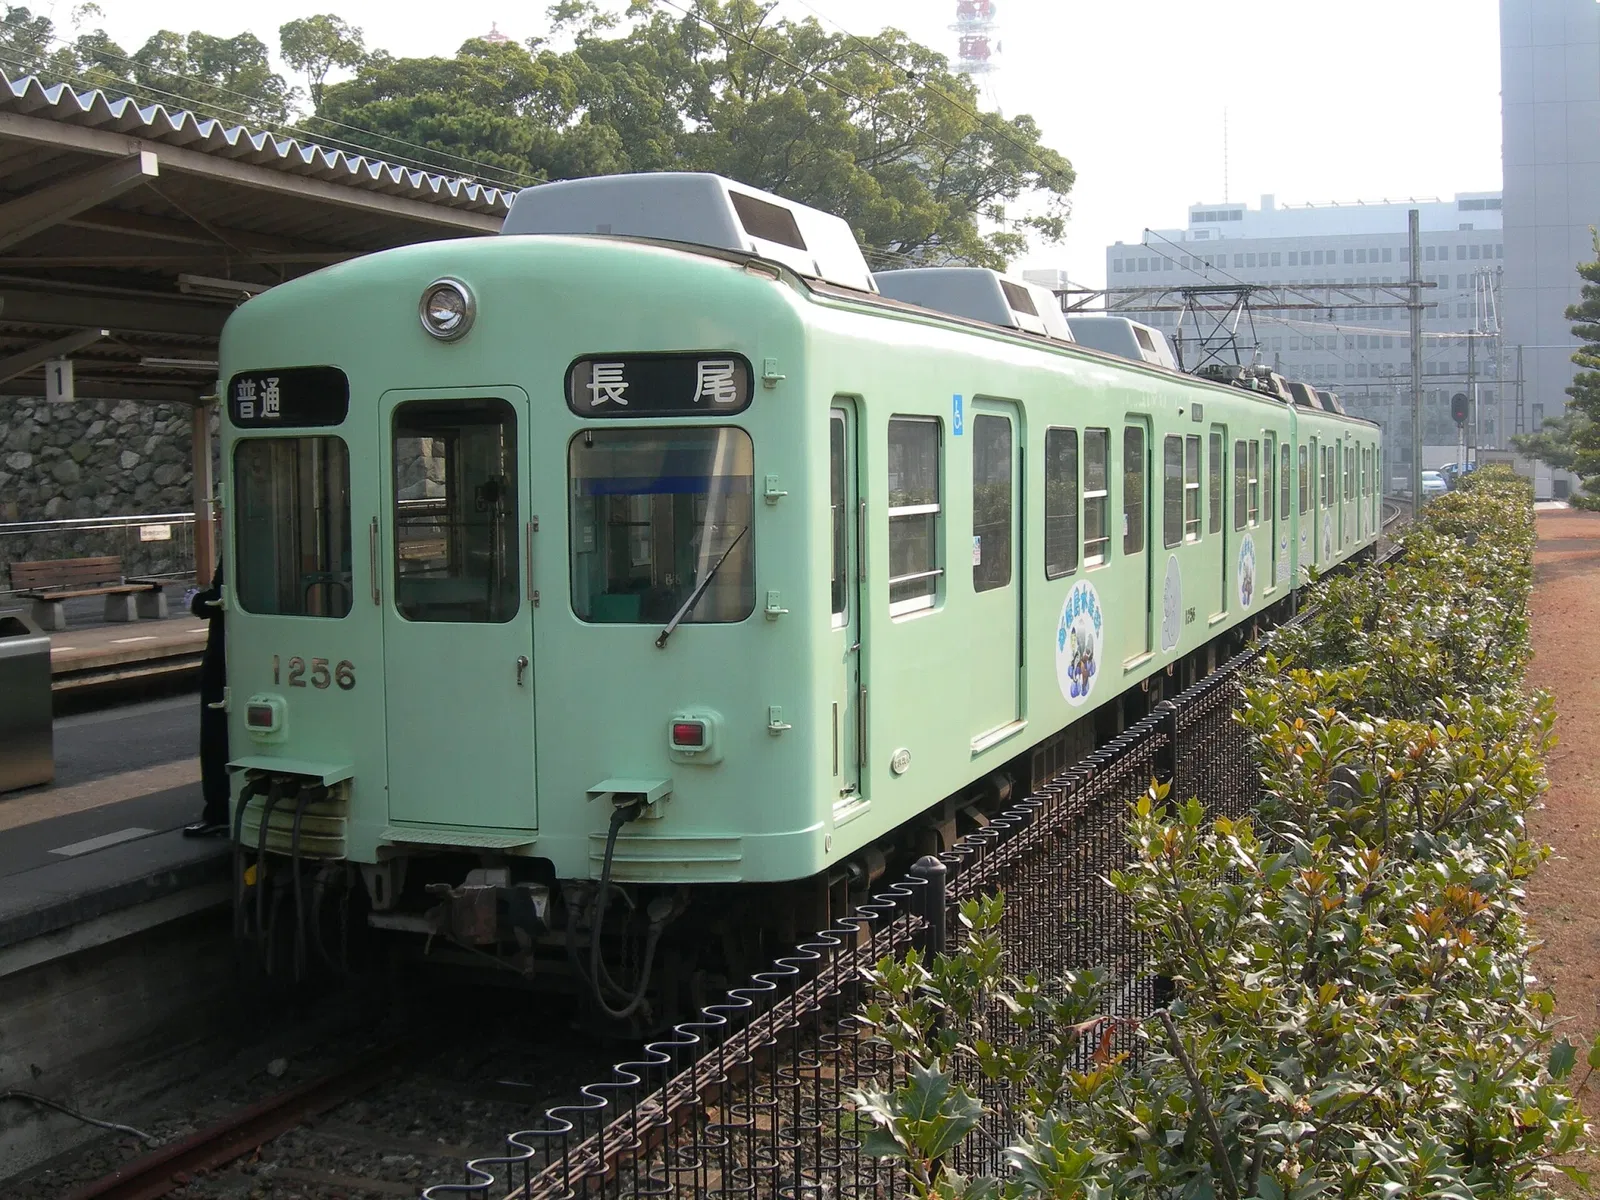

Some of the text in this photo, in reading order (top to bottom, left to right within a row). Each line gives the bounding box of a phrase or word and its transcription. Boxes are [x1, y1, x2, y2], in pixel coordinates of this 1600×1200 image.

[54, 366, 63, 396] 1
[237, 377, 281, 419] 普通
[586, 360, 737, 406] 長尾
[272, 654, 356, 691] 1256
